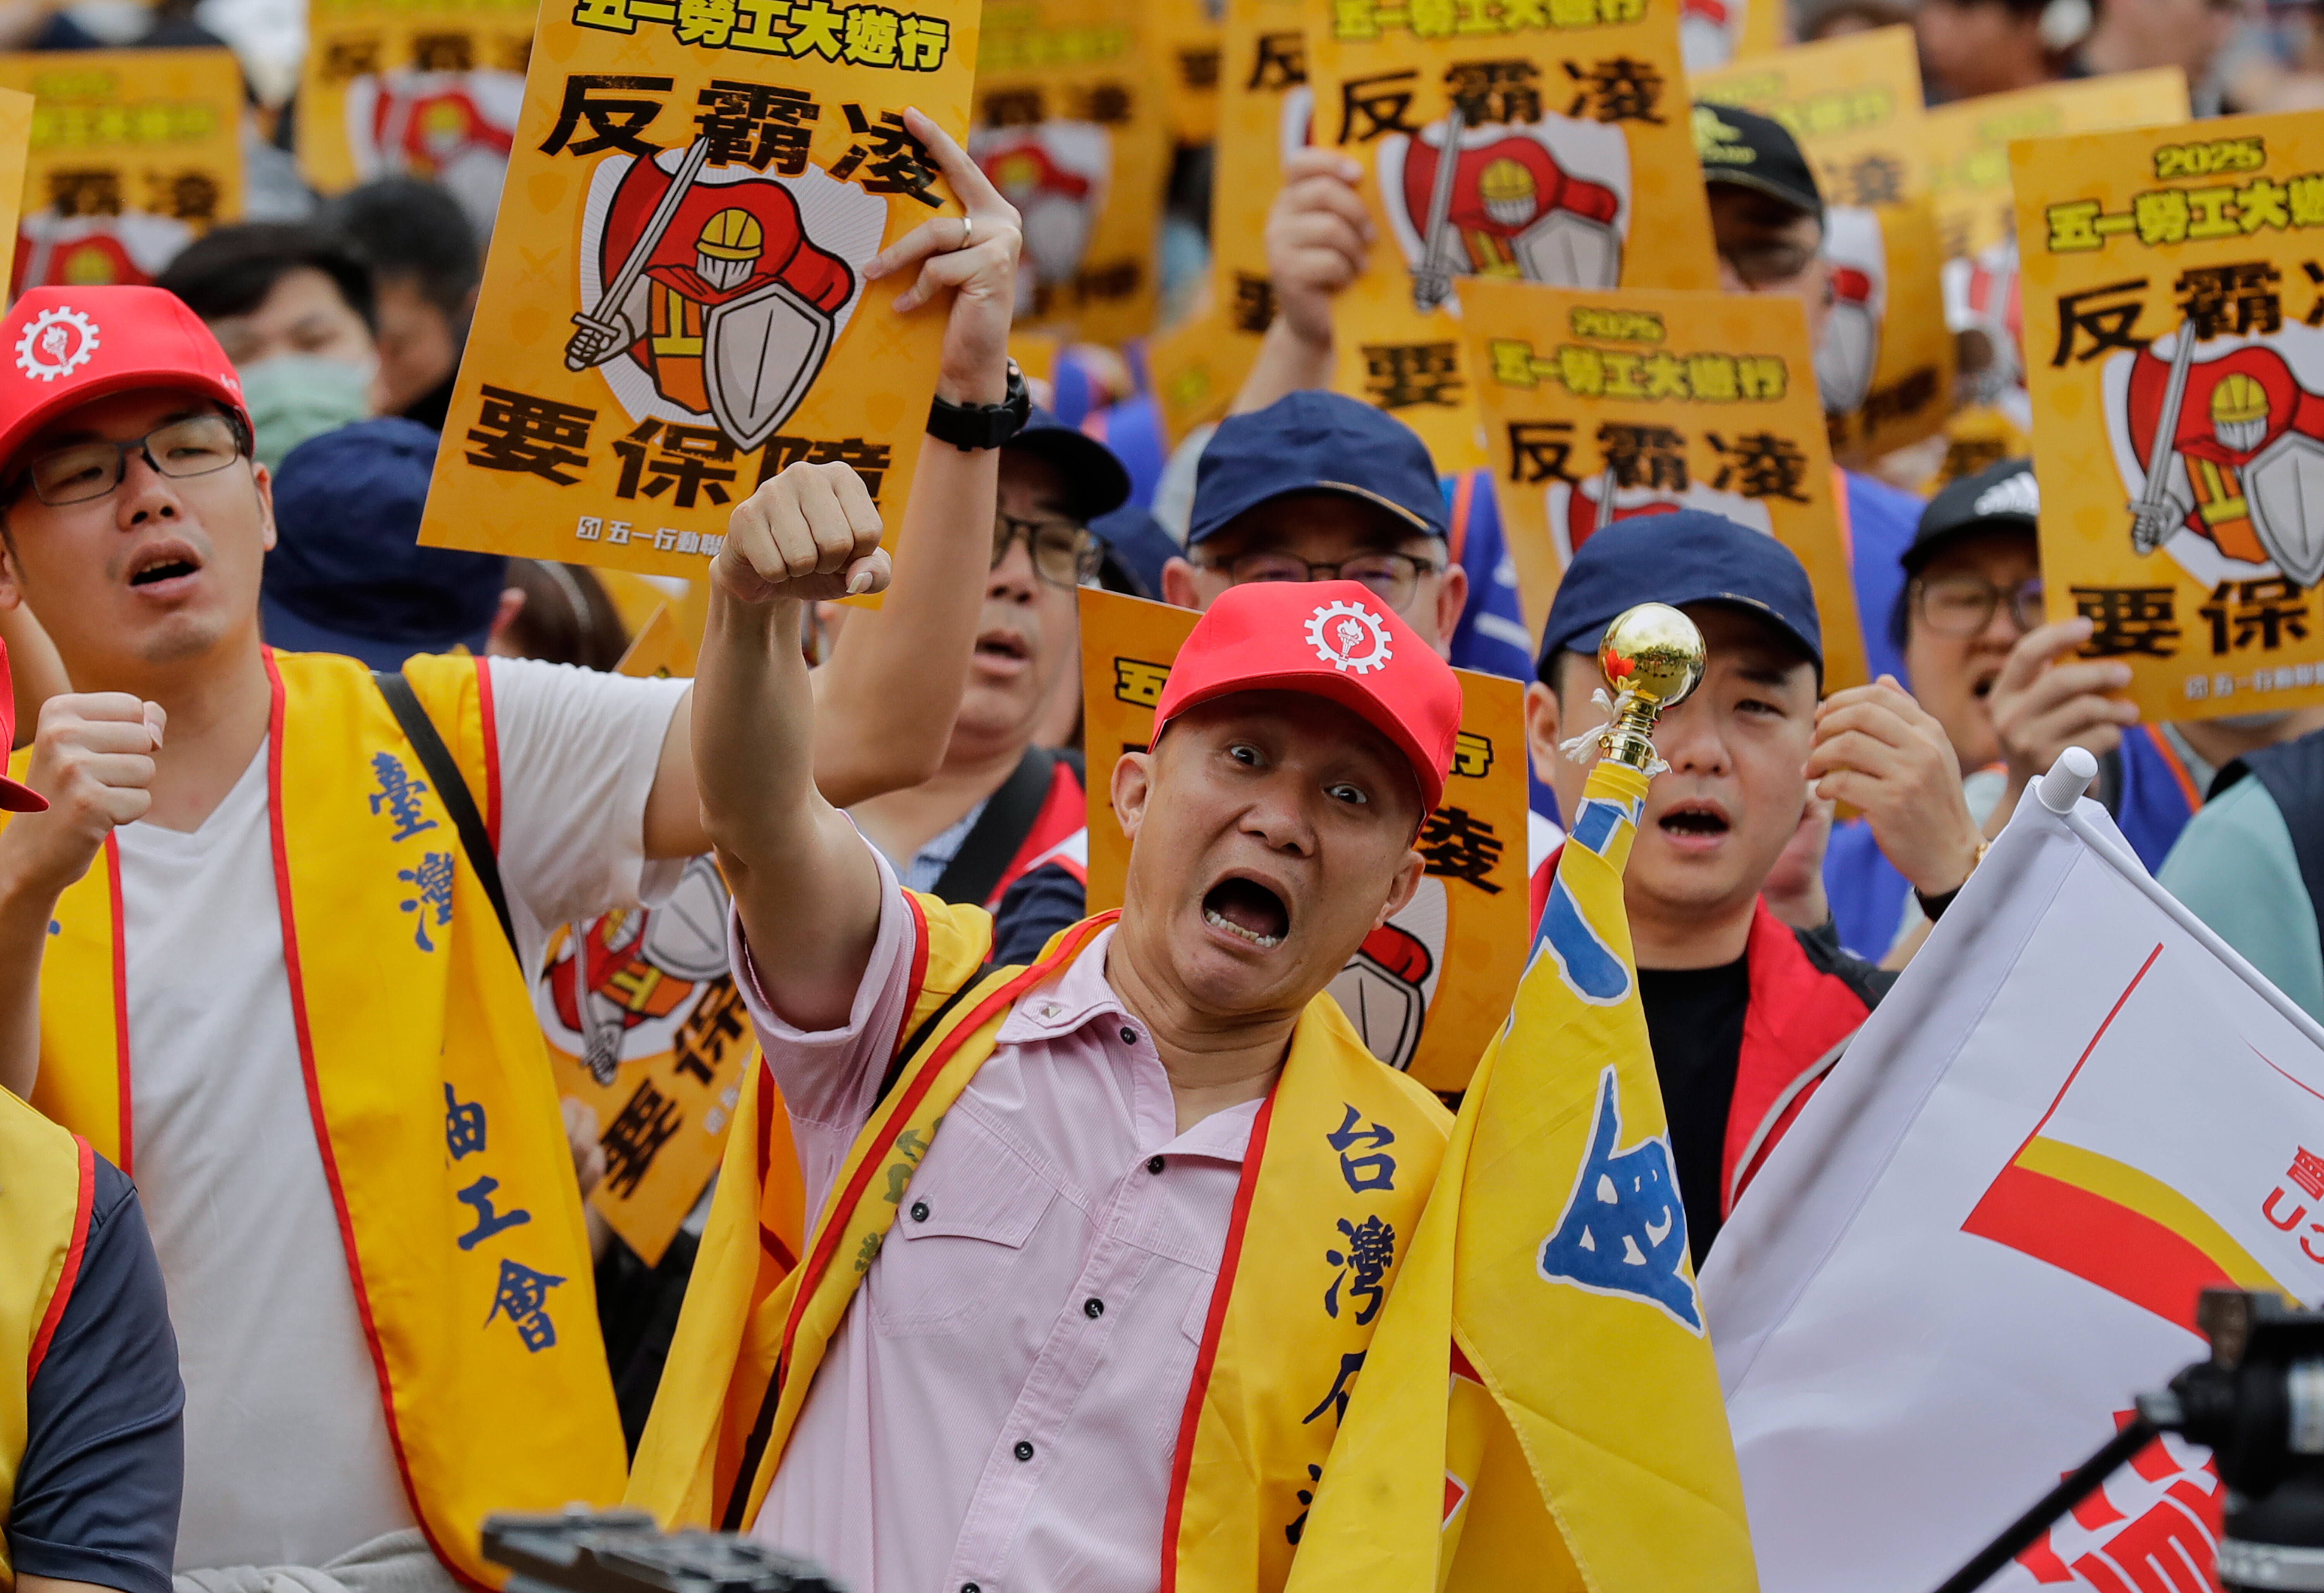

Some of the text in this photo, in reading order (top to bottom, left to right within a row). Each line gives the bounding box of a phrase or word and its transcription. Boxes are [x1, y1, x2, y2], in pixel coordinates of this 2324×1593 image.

[542, 75, 946, 208] 反霸凌
[1337, 57, 1667, 145] 反霸凌
[2153, 136, 2267, 180] 2025
[2051, 261, 2324, 368] 反霸
[1507, 419, 1812, 503] 反霸凌
